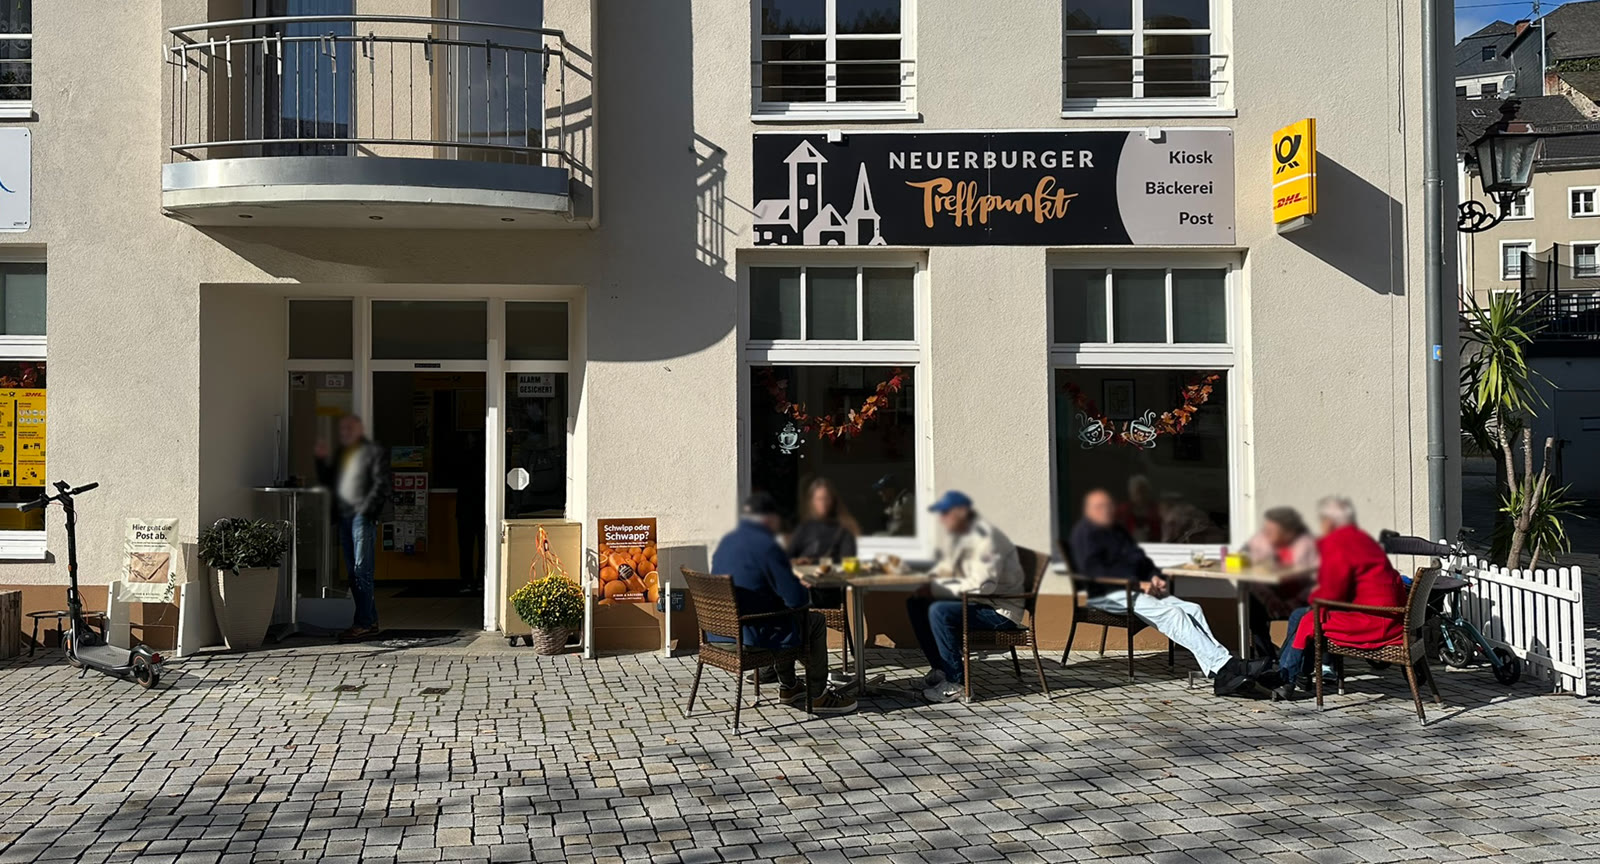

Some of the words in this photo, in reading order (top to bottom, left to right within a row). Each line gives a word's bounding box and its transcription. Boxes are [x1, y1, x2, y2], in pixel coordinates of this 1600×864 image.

[889, 150, 1094, 170] NEUERBURGER
[1169, 151, 1213, 164] Kiosk
[1145, 181, 1213, 195] Bäckerei
[905, 176, 1079, 228] Treffpunkt
[1276, 193, 1302, 208] DHL
[1179, 211, 1214, 225] Post
[604, 524, 633, 532] Schwipp
[136, 531, 153, 540] Post
[154, 531, 167, 540] ab.
[605, 531, 649, 541] Schwapp?
